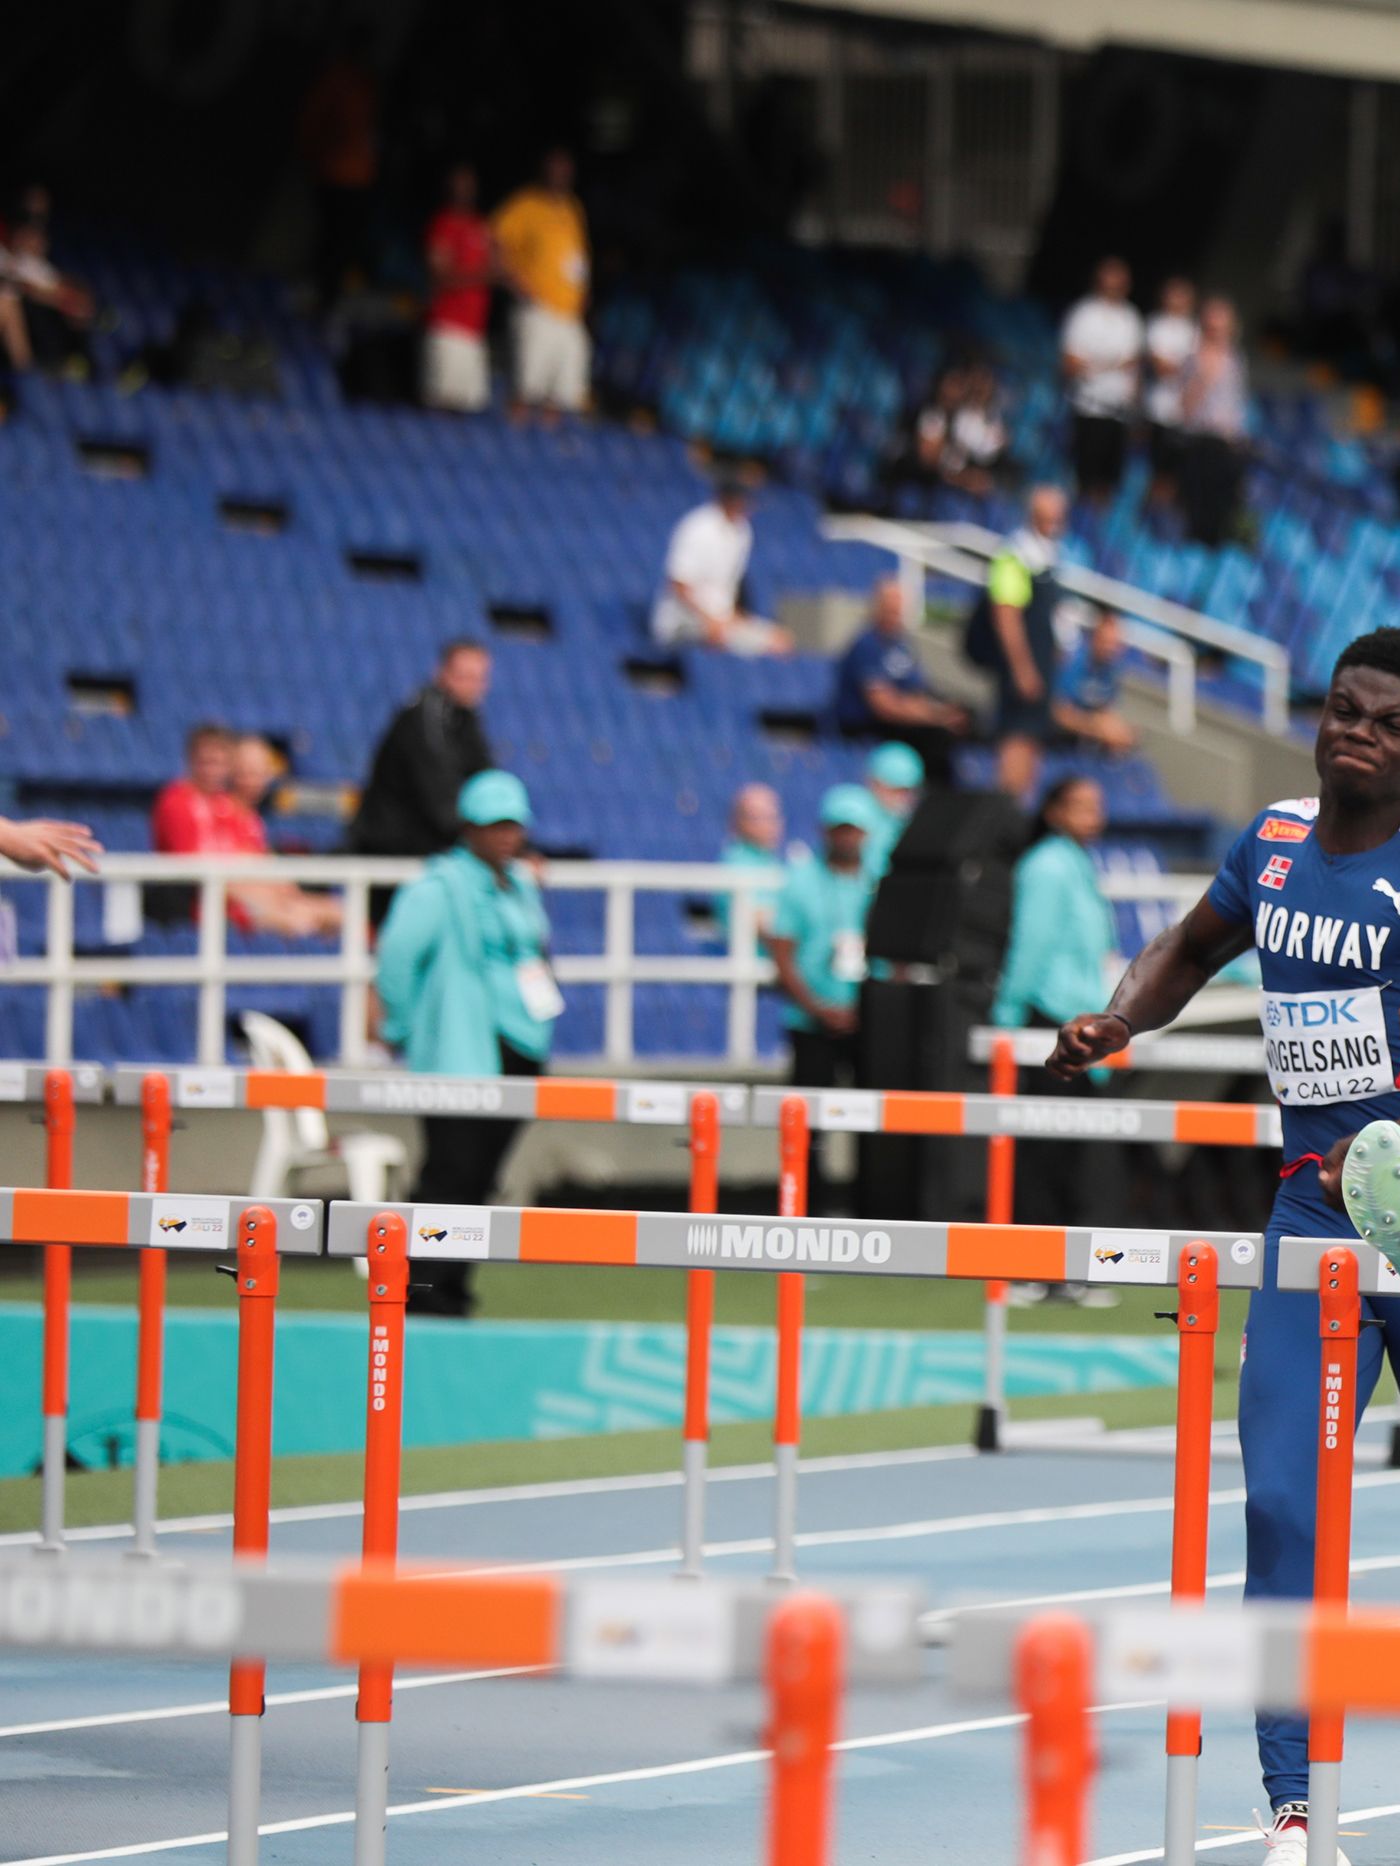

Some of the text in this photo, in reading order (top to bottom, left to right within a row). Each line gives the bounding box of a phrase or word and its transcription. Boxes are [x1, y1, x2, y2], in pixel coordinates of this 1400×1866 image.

[1255, 900, 1391, 971] NORWAY
[1280, 997, 1360, 1027] TDK
[386, 1083, 502, 1111] MONDO
[1298, 1077, 1377, 1099] CALI 22
[721, 1225, 892, 1264] MONDO
[373, 1339, 389, 1411] MONDO
[1325, 1377, 1342, 1449] MONDO
